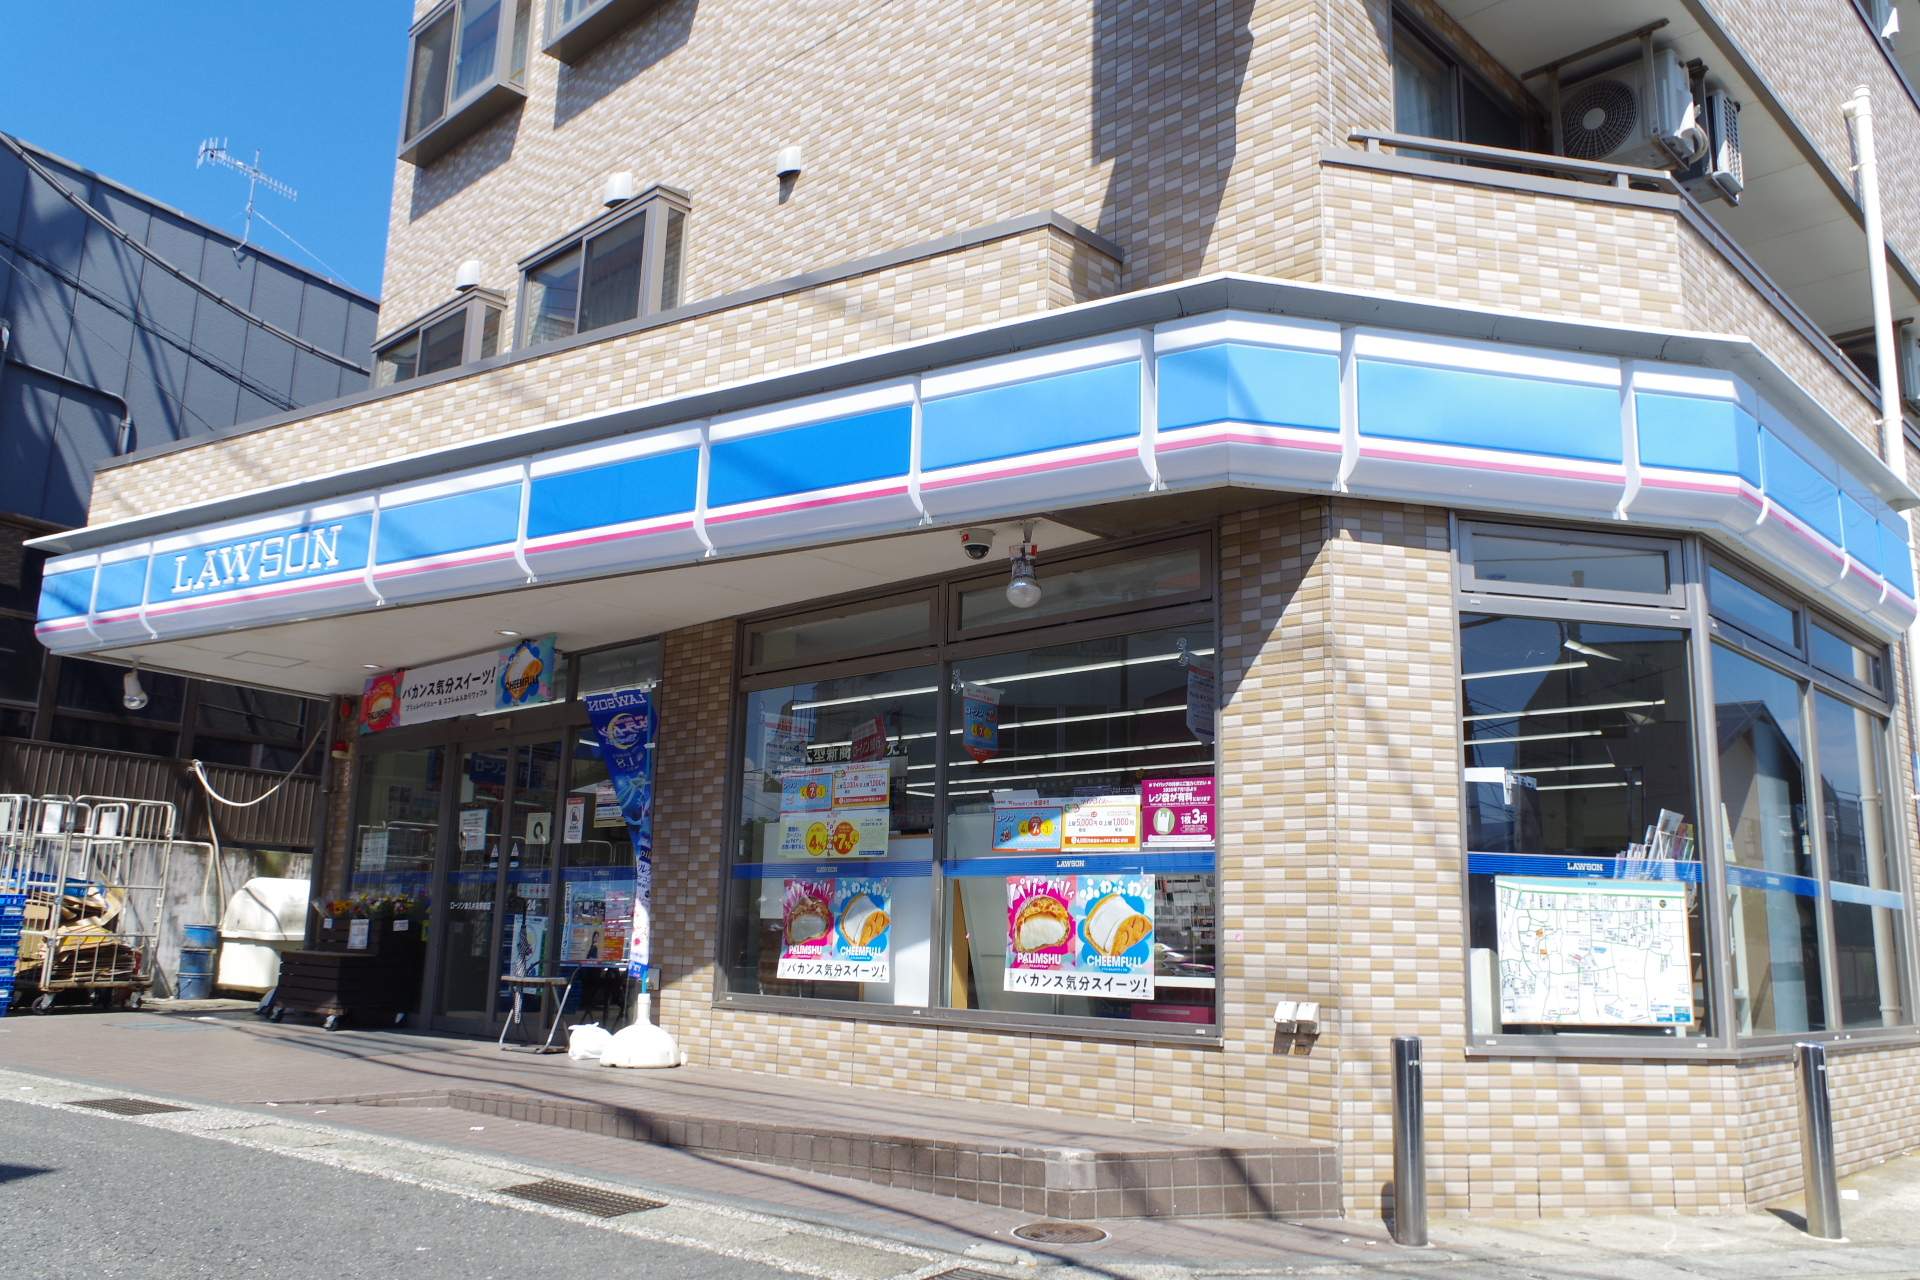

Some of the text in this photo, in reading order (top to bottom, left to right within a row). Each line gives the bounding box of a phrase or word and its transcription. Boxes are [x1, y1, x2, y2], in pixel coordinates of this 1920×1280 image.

[171, 524, 343, 594] LAWSON
[402, 666, 496, 699] バカンス気分スイーツ!
[1181, 808, 1208, 825] 1枚3円
[1567, 861, 1604, 872] LAWSON
[788, 945, 823, 955] PALIMSHU
[1017, 953, 1061, 965] PALIMSHU
[1086, 955, 1143, 967] CHEEMFULL
[786, 963, 886, 978] バカンス気分スイーツ!
[1015, 974, 1148, 993] バカンス気分スイーツ!
